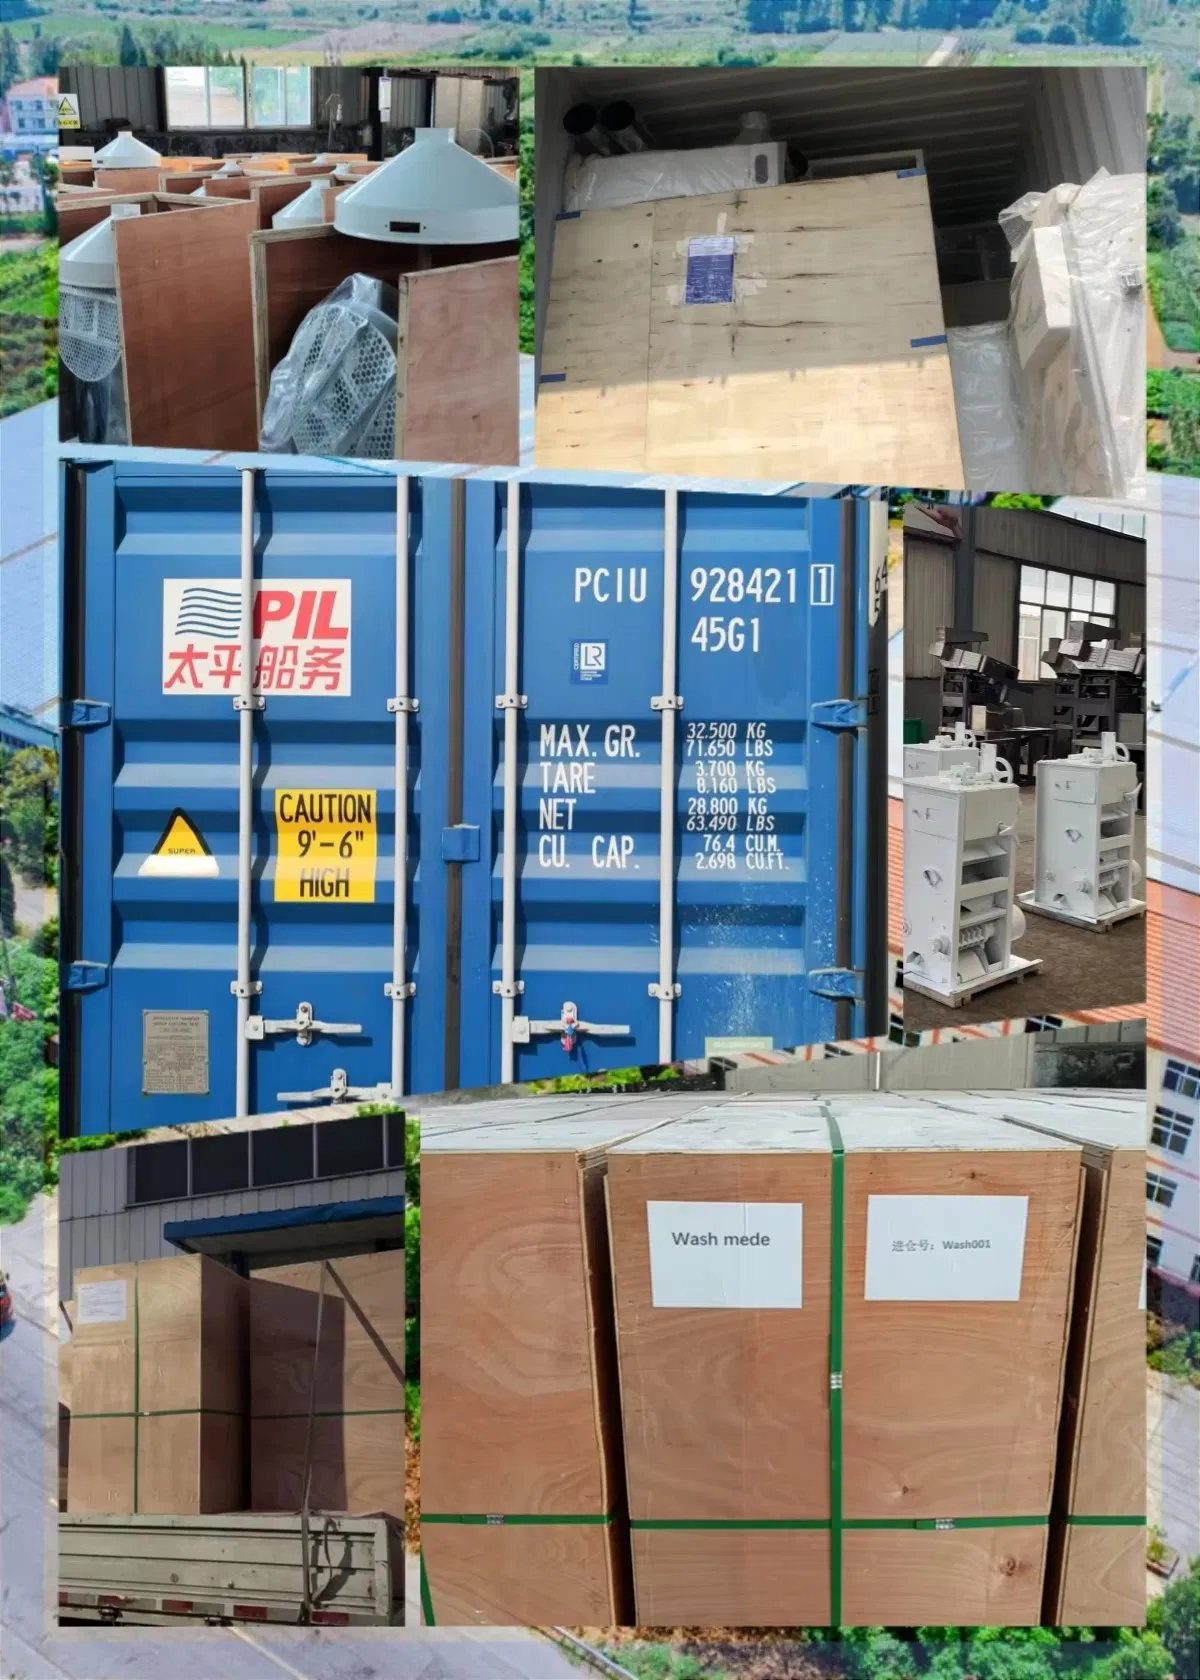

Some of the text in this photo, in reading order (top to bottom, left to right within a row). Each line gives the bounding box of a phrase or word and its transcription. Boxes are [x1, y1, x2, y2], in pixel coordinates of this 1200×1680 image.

[574, 567, 648, 603] PCIU
[690, 568, 797, 603] 928421
[252, 590, 349, 640] PIL
[691, 617, 760, 652] 45G1
[164, 643, 345, 690] 太平船务
[540, 722, 767, 758] MAX. GR. 32.500 KG
[686, 739, 773, 757] 71.650 LBS
[540, 760, 765, 794] TARE 3.700 KG
[747, 777, 777, 794] LBS
[279, 793, 372, 824] CAUTION
[539, 797, 768, 830] NET 28.800 KG
[686, 815, 776, 832] 63.490 LBS
[167, 847, 196, 855] SUPER
[538, 835, 570, 868] CU.
[591, 835, 640, 869] CAP.
[703, 834, 736, 852] 76.4
[695, 852, 737, 869] 2.698
[299, 868, 350, 897] HIGH
[671, 1231, 770, 1246] Wash mede
[942, 1239, 991, 1250] Wash001
